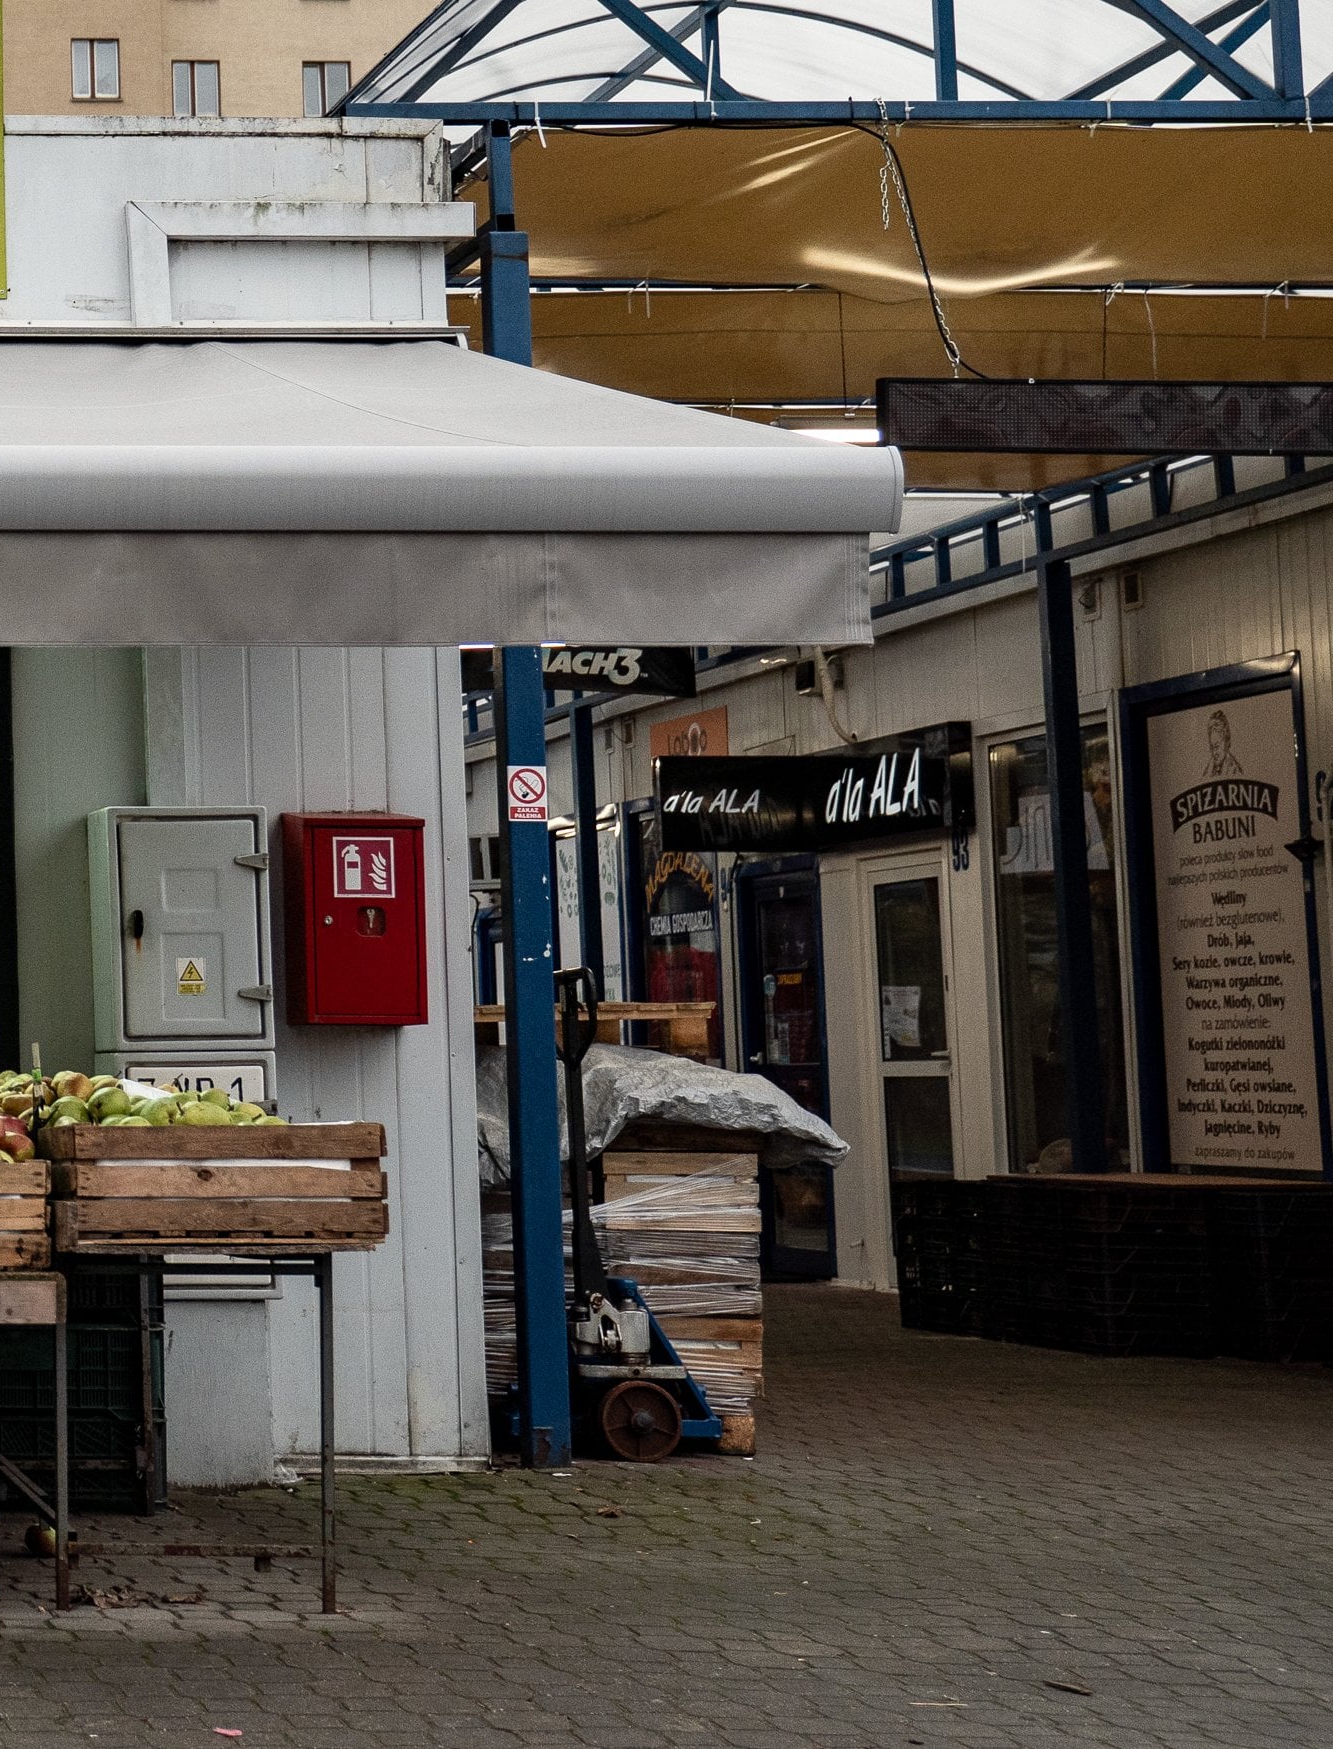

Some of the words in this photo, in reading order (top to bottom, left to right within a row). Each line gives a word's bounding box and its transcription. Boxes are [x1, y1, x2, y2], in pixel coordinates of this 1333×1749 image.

[869, 748, 921, 819] ALA
[708, 789, 760, 814] ALA
[1193, 815, 1256, 844] BABUNI
[650, 916, 671, 936] CHEMIA
[1186, 976, 1226, 992] Warzywa
